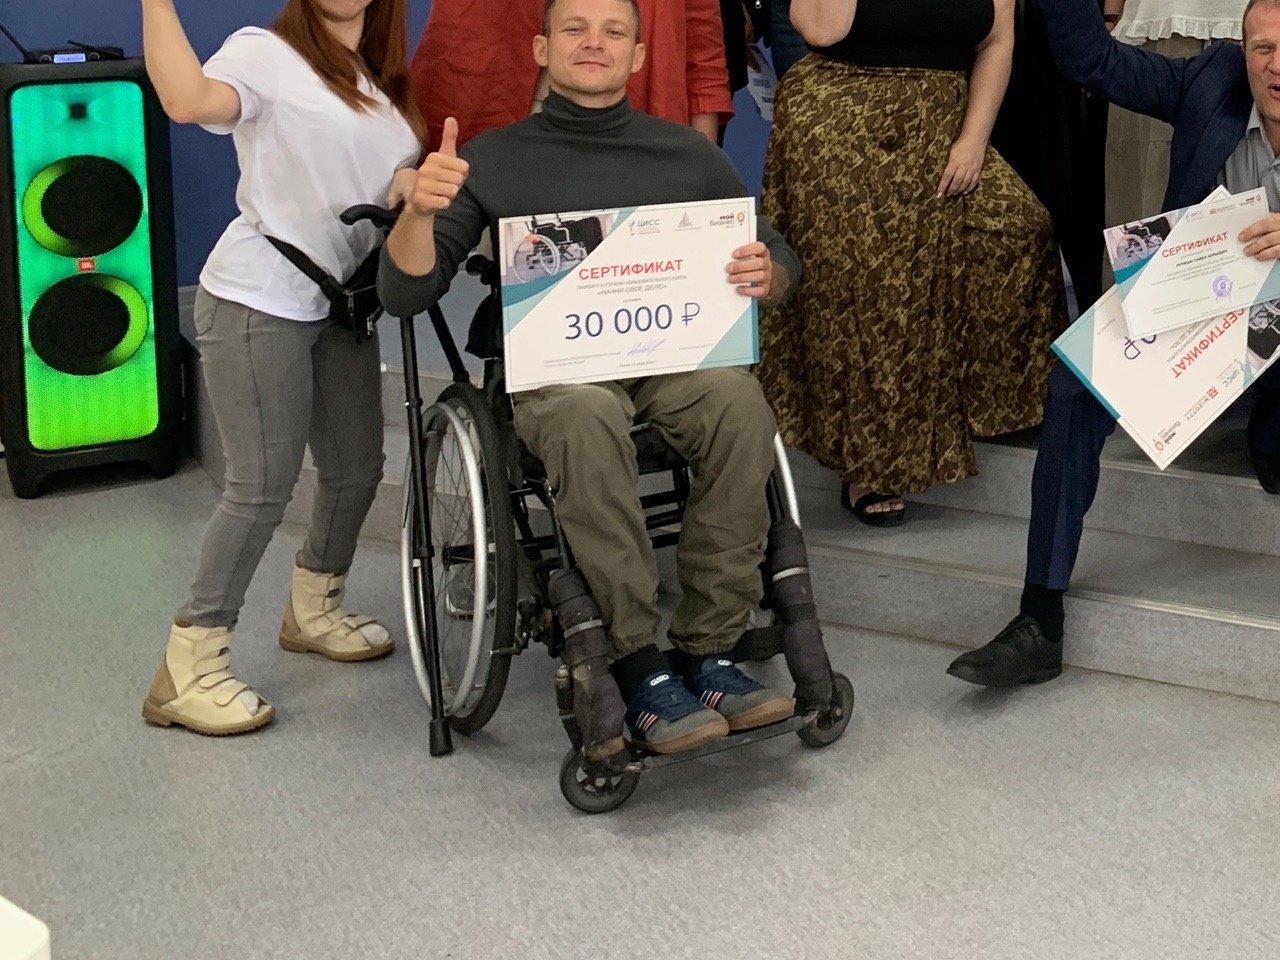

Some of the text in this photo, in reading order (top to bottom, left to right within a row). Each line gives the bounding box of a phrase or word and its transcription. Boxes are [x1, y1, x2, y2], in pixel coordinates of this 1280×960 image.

[1161, 232, 1228, 259] СЕРТИФИКАТ
[579, 259, 683, 280] СЕРТИФИКАТ
[565, 311, 603, 340] 30
[614, 304, 673, 334] 000
[1171, 308, 1245, 379] СЕРТИФИКАТ
